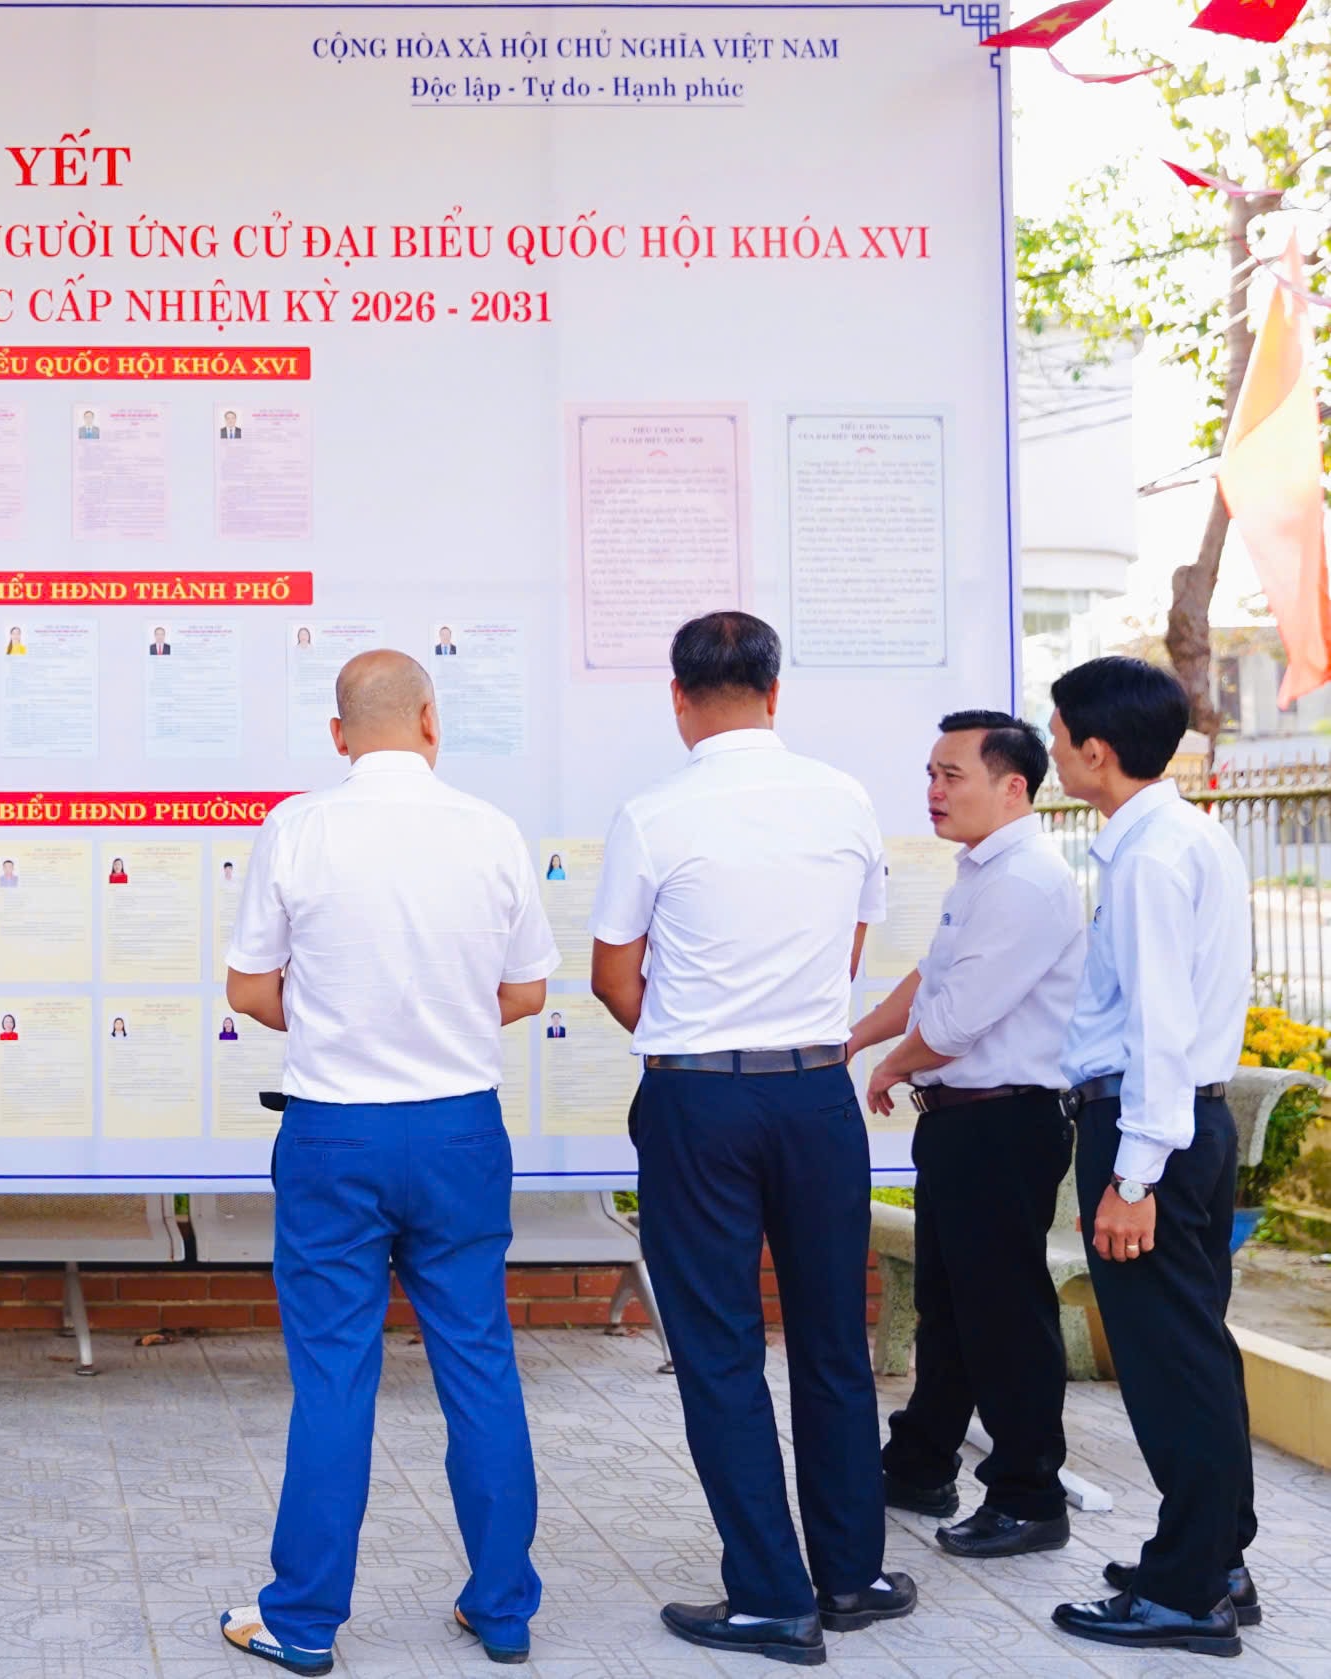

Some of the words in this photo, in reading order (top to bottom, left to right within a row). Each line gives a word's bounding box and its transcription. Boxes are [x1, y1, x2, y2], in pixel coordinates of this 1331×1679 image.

[312, 31, 387, 63] CỘNG
[395, 31, 452, 59] HÒA
[457, 32, 493, 59] XÃ
[500, 31, 548, 63] HỘI
[556, 29, 612, 59] CHỦ
[620, 32, 706, 59] NGHĨA
[712, 31, 774, 63] VIỆT
[781, 38, 839, 59] NAM
[411, 76, 457, 103] Độc
[464, 76, 501, 103] lập
[521, 76, 556, 103] Tự
[561, 75, 591, 97] do
[612, 76, 677, 103] Hạnh
[685, 76, 744, 103] phúc
[4, 127, 132, 187] YẾT
[127, 214, 218, 259] ỨNG
[232, 211, 293, 259] CỬ
[302, 225, 377, 268] ĐẠI
[391, 205, 493, 259] BIỂU
[506, 209, 626, 266] QUỐC
[639, 214, 717, 269] HỘI
[730, 215, 849, 259] KHÓA
[859, 225, 930, 259] XVI
[28, 274, 113, 323] CẤP
[125, 278, 270, 332] NHIỆM
[284, 277, 339, 323] KỲ
[351, 291, 436, 323] 2026
[470, 291, 552, 323] 2031
[35, 350, 110, 378] QUỐC
[117, 352, 165, 378] HỘI
[172, 352, 248, 375] KHÓA
[251, 357, 298, 375] XVI
[50, 582, 128, 600] HĐND
[133, 577, 226, 600] THÀNH
[234, 574, 290, 600] PHỐ
[70, 802, 147, 820] HĐND
[155, 796, 268, 821] PHƯỜNG
